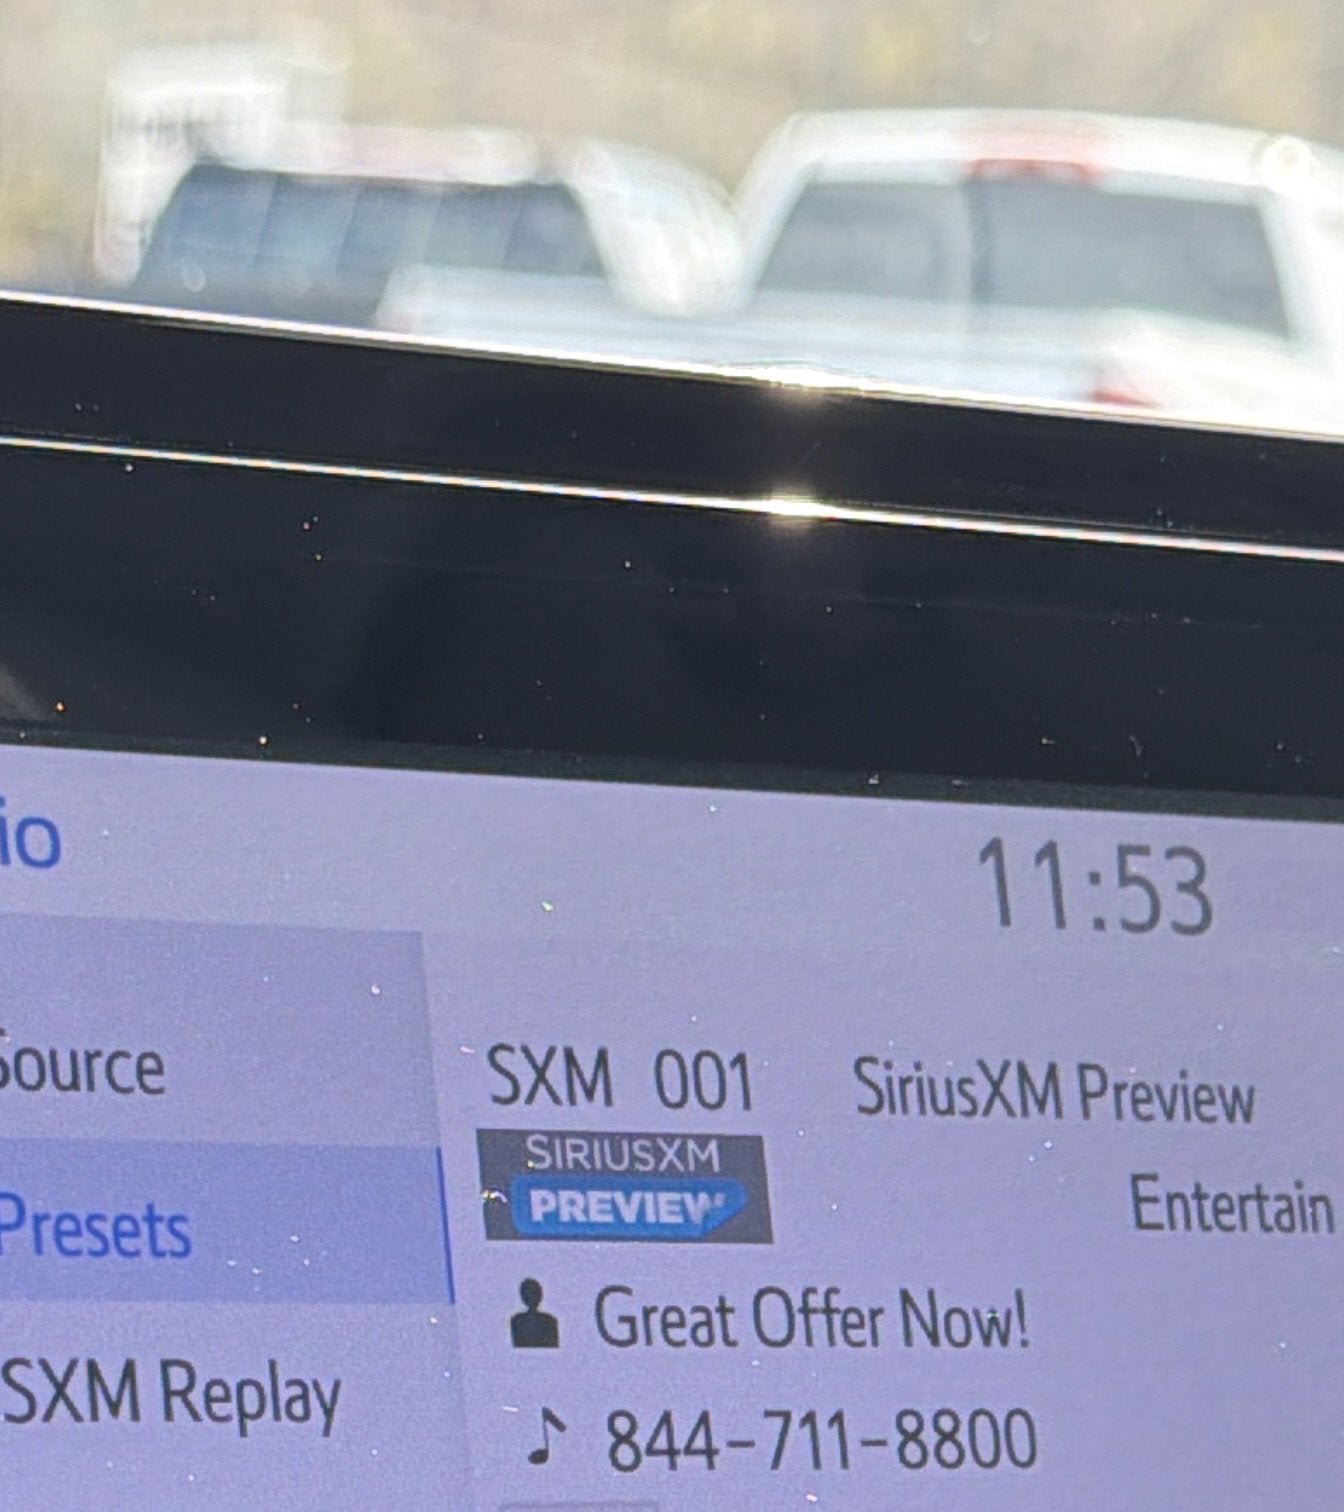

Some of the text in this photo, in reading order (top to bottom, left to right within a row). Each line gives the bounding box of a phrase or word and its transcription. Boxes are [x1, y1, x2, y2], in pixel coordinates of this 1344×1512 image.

[978, 836, 1215, 937] 11:53
[486, 1043, 754, 1112] SXM 001
[853, 1056, 1256, 1124] SiriusXM Preview
[524, 1134, 721, 1173] SIRIUSXM
[530, 1189, 727, 1224] PREVIEW
[1130, 1172, 1336, 1235] Entertain
[594, 1285, 1031, 1349] Great Offer Now!
[0, 1357, 343, 1438] SXM Replay
[606, 1408, 1039, 1474] 844-711-8800
